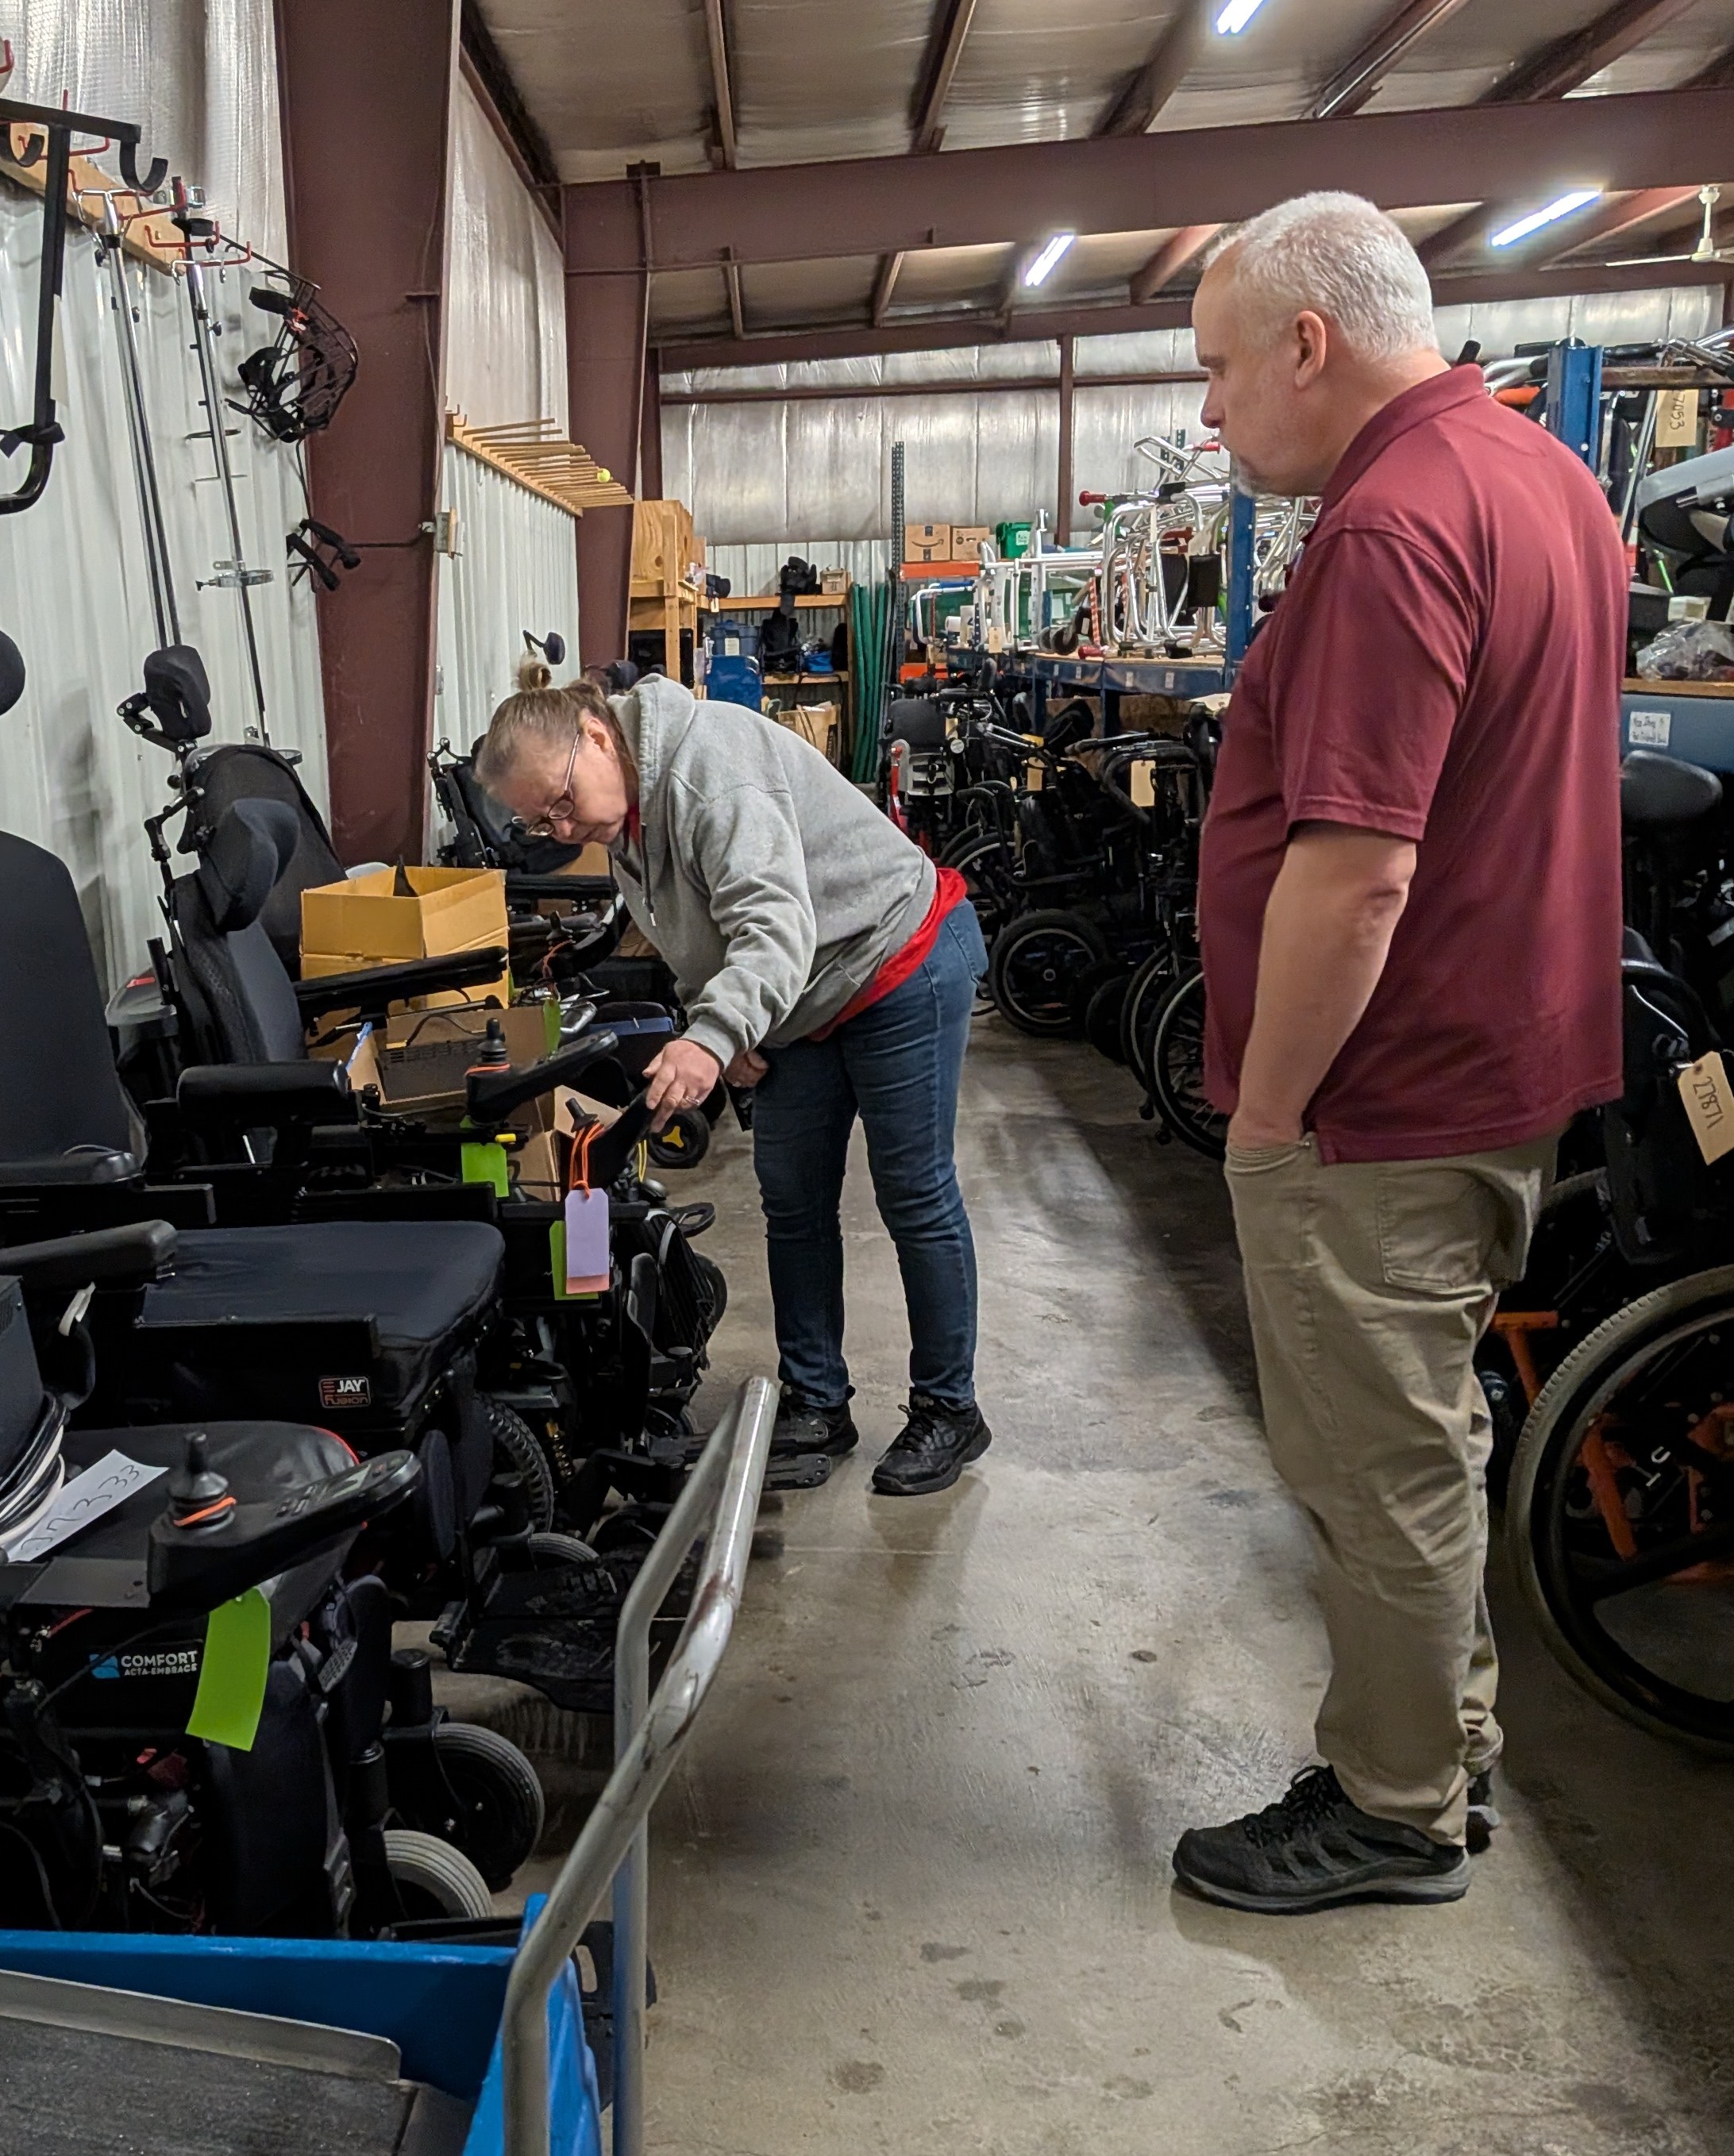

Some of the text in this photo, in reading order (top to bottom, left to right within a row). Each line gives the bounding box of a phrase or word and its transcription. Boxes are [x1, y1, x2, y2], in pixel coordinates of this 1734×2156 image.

[1693, 1076, 1724, 1130] 27871
[337, 1379, 365, 1393] JAY
[121, 1650, 198, 1668] COMFORT
